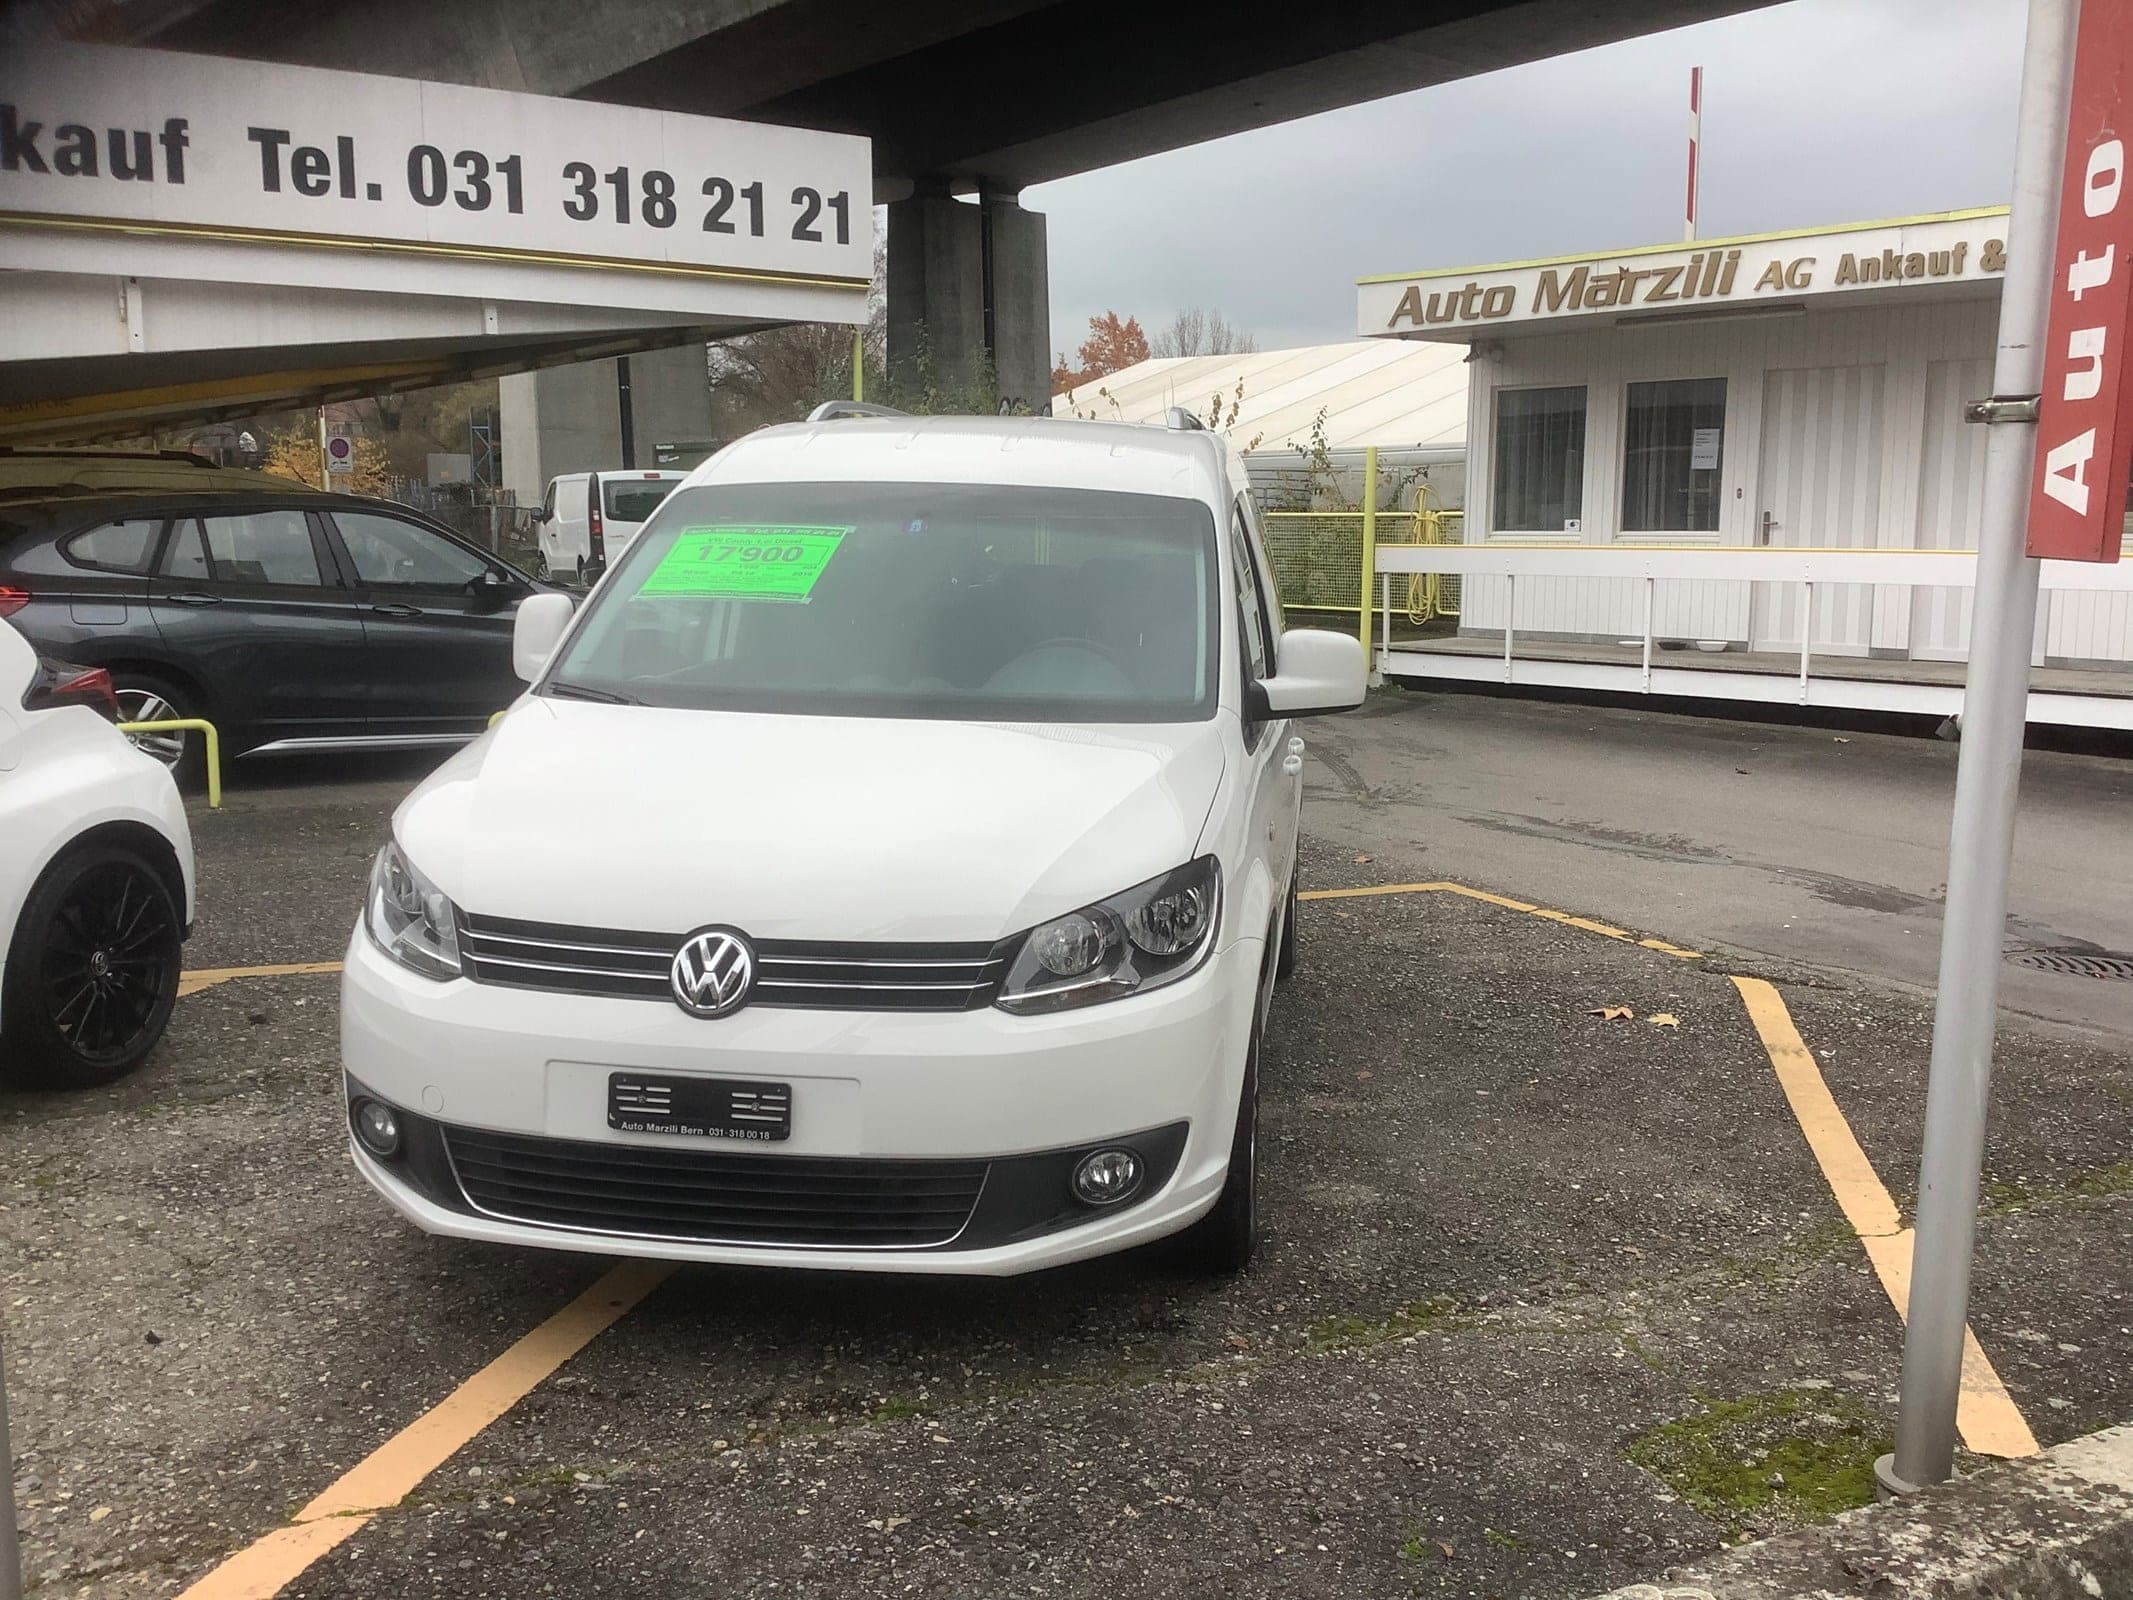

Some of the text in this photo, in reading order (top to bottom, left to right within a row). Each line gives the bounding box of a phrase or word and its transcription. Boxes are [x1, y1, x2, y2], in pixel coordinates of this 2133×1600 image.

[0, 104, 850, 245] kauf Tel. 031 318 21 21
[1387, 238, 2006, 328] Auto Marzili AG Ankauf &
[2043, 138, 2125, 518] Auto
[698, 544, 804, 562] 17'900
[621, 1121, 644, 1131] Auto
[646, 1122, 679, 1134] Marzili
[680, 1125, 704, 1136] Bern
